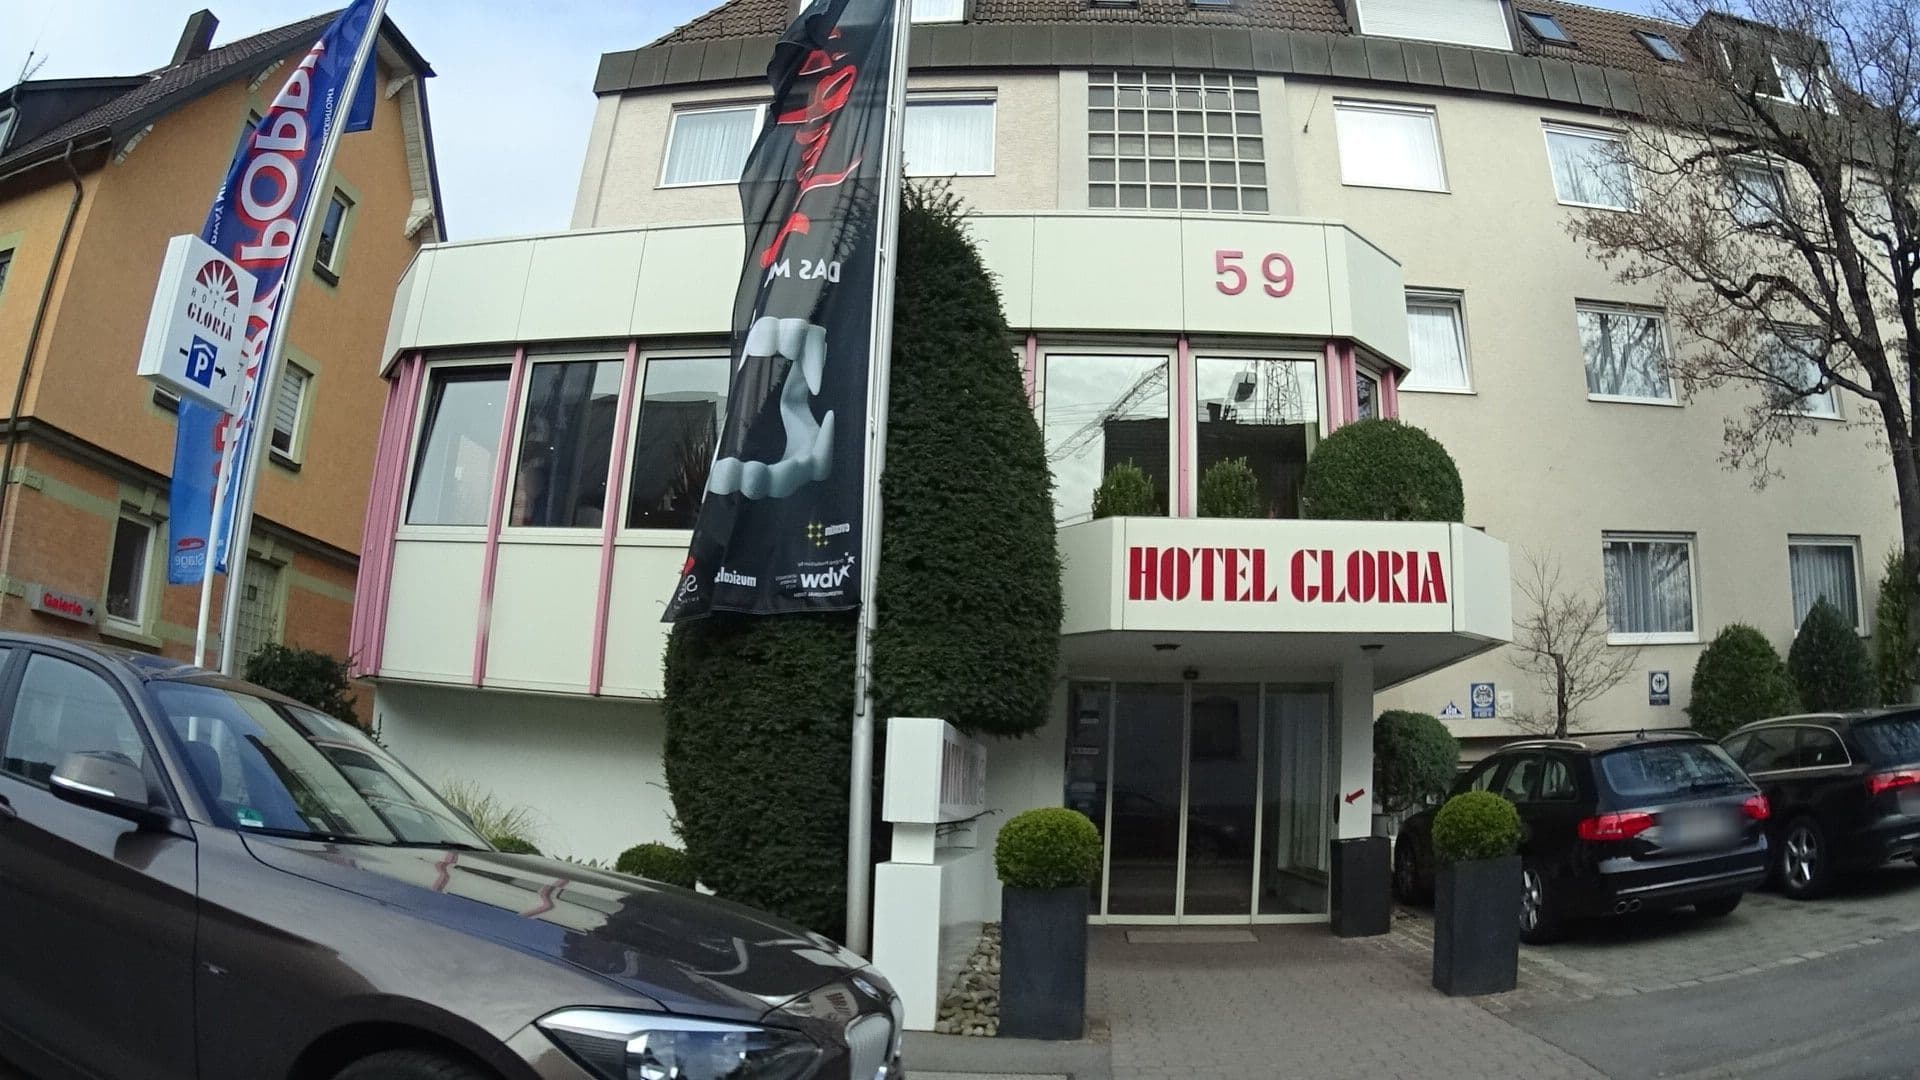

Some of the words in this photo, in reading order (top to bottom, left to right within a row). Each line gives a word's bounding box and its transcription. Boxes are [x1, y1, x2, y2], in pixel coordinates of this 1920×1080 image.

[1215, 249, 1295, 299] 59
[187, 302, 233, 342] GLORIA
[191, 287, 236, 323] HOTEL
[1128, 546, 1278, 602] HOTEL
[1290, 549, 1448, 604] GLORIA
[43, 592, 83, 617] Galerie
